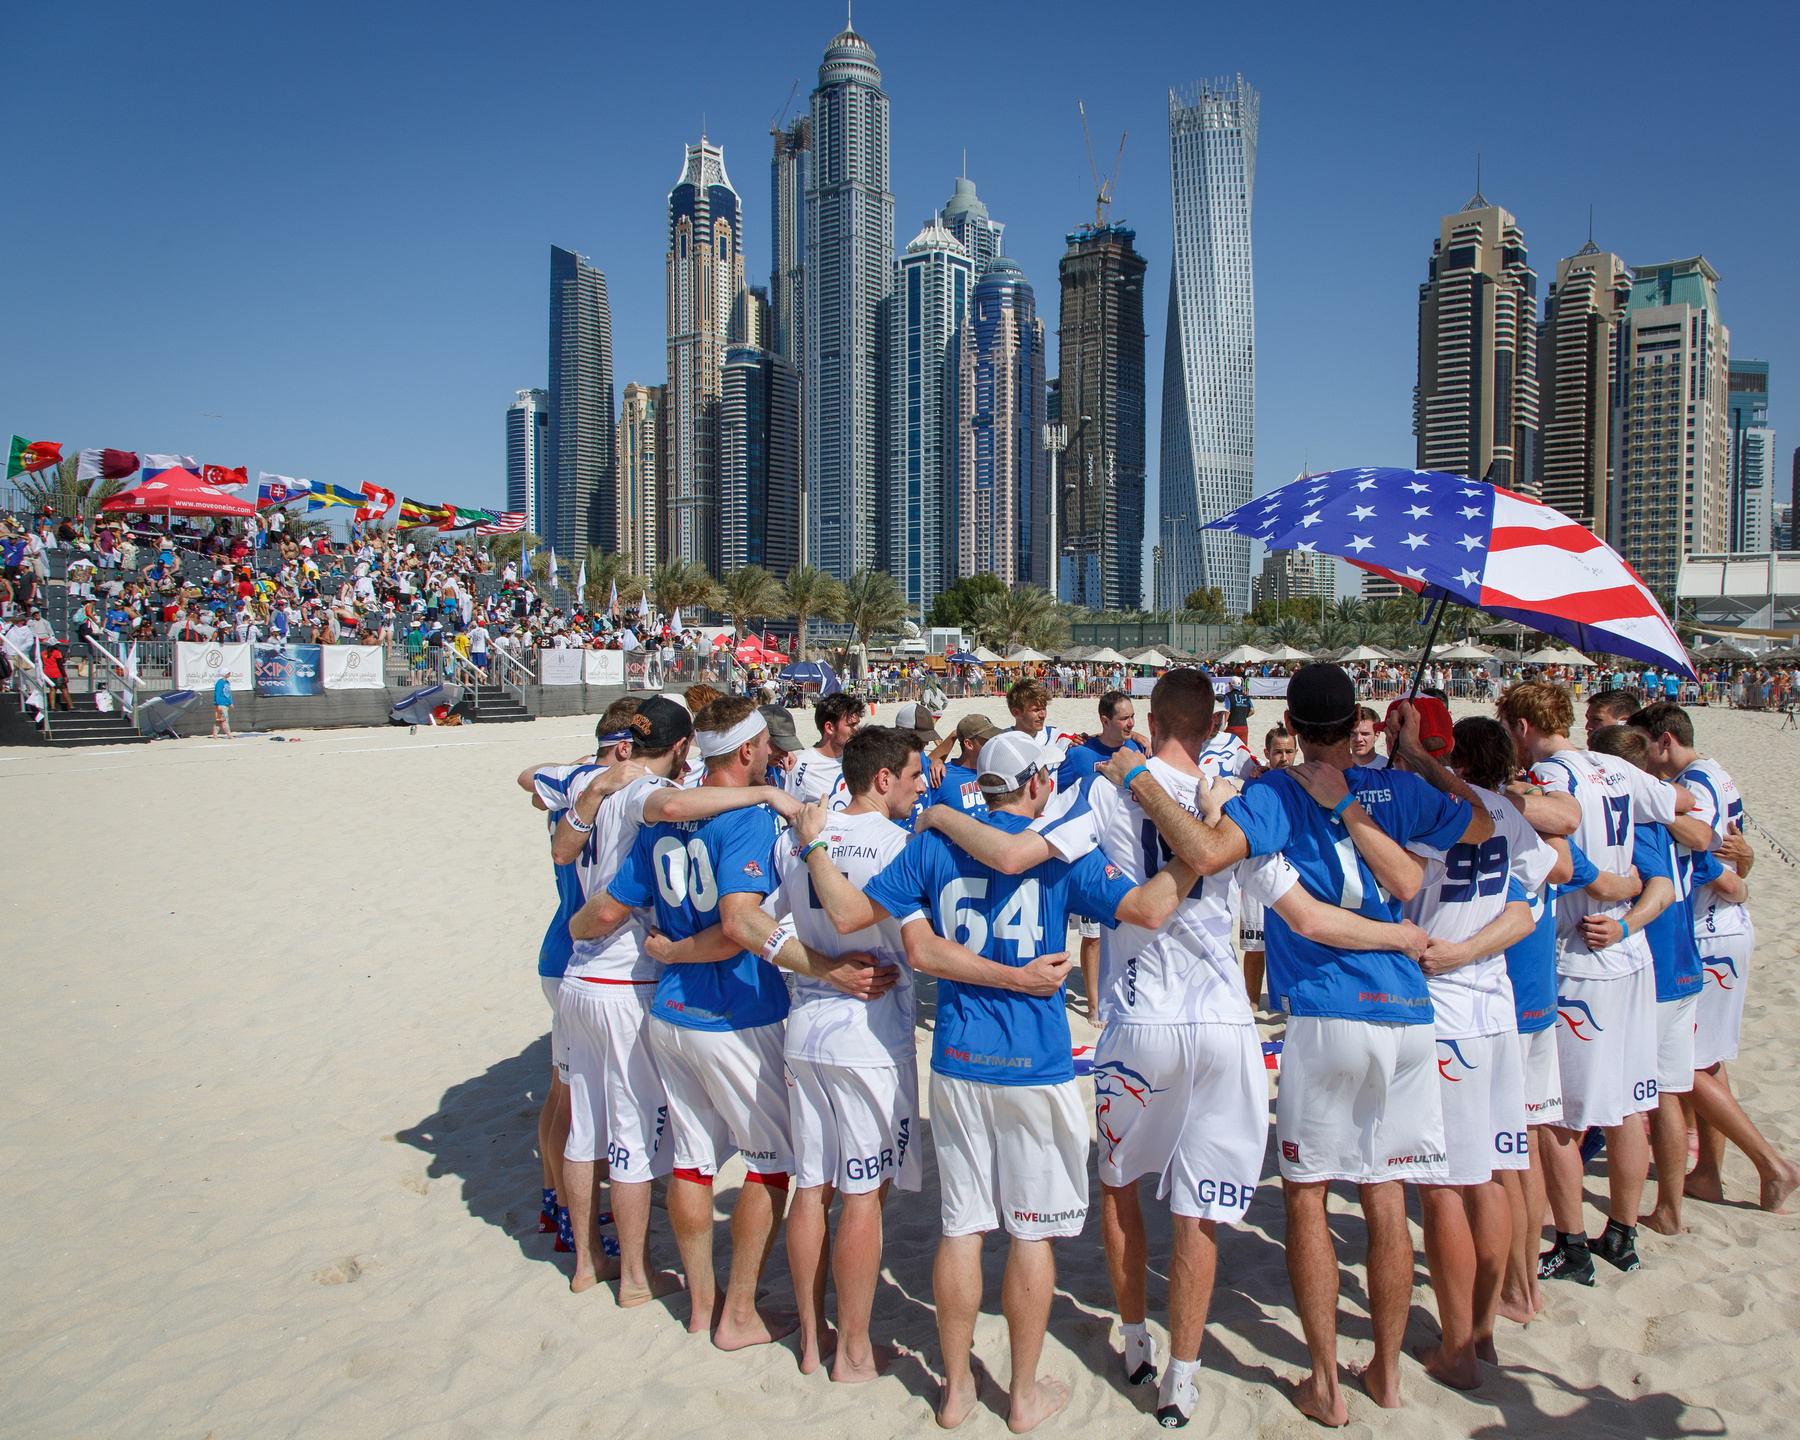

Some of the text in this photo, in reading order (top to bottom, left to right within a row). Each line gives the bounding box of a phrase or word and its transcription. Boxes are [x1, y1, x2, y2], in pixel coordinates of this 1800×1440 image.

[174, 499, 252, 514] www.moveoneinc.com
[795, 762, 808, 787] GAIA
[653, 836, 718, 913] 00
[1439, 835, 1510, 903] 99
[940, 877, 1044, 958] 64
[767, 927, 787, 948] USA
[1127, 957, 1137, 1008] GAIA
[945, 1047, 1032, 1068] FIVEULTIMATE
[1633, 1079, 1657, 1101] GB
[1494, 1132, 1529, 1154] GB
[607, 1142, 630, 1170] BR
[738, 1150, 777, 1160] TIMATE
[847, 1148, 893, 1180] GBR
[1388, 1152, 1447, 1166] FIVEULTIM
